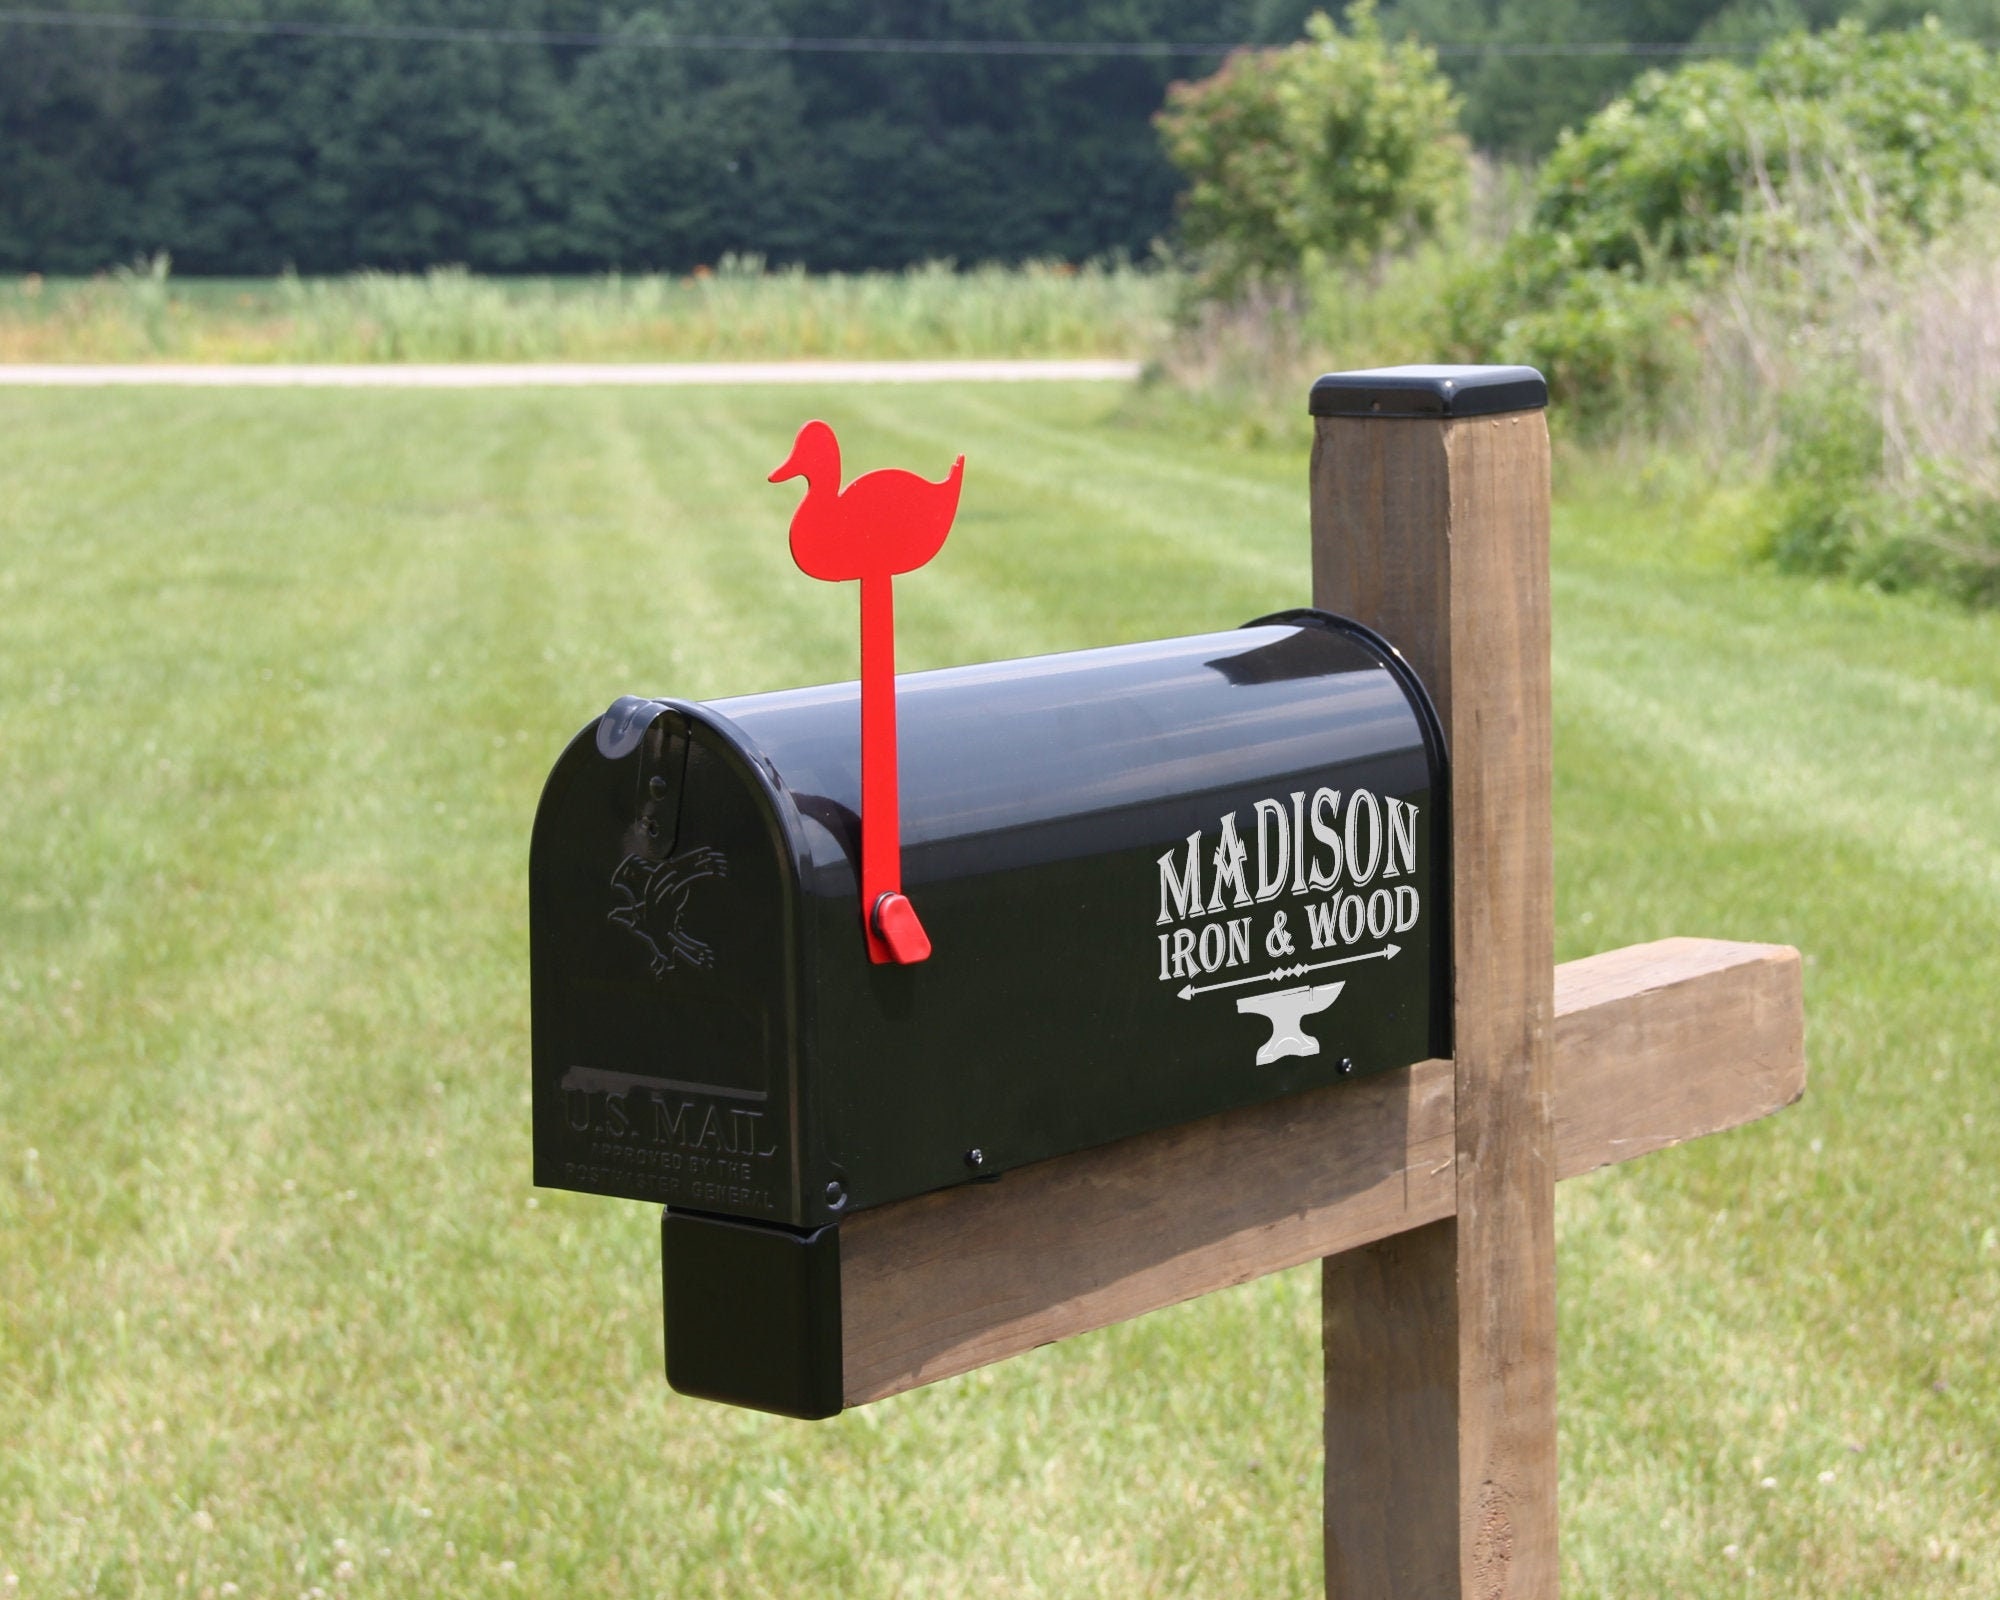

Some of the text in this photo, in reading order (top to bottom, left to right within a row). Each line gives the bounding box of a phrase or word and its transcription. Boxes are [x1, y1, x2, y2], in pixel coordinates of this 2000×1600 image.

[1156, 787, 1419, 926] MADISON
[1158, 885, 1420, 981] IRON & WOOD
[565, 1088, 778, 1157] U.S. MAIL
[591, 1141, 752, 1180] APPROVED BY THE
[691, 1180, 776, 1209] GENERAL
